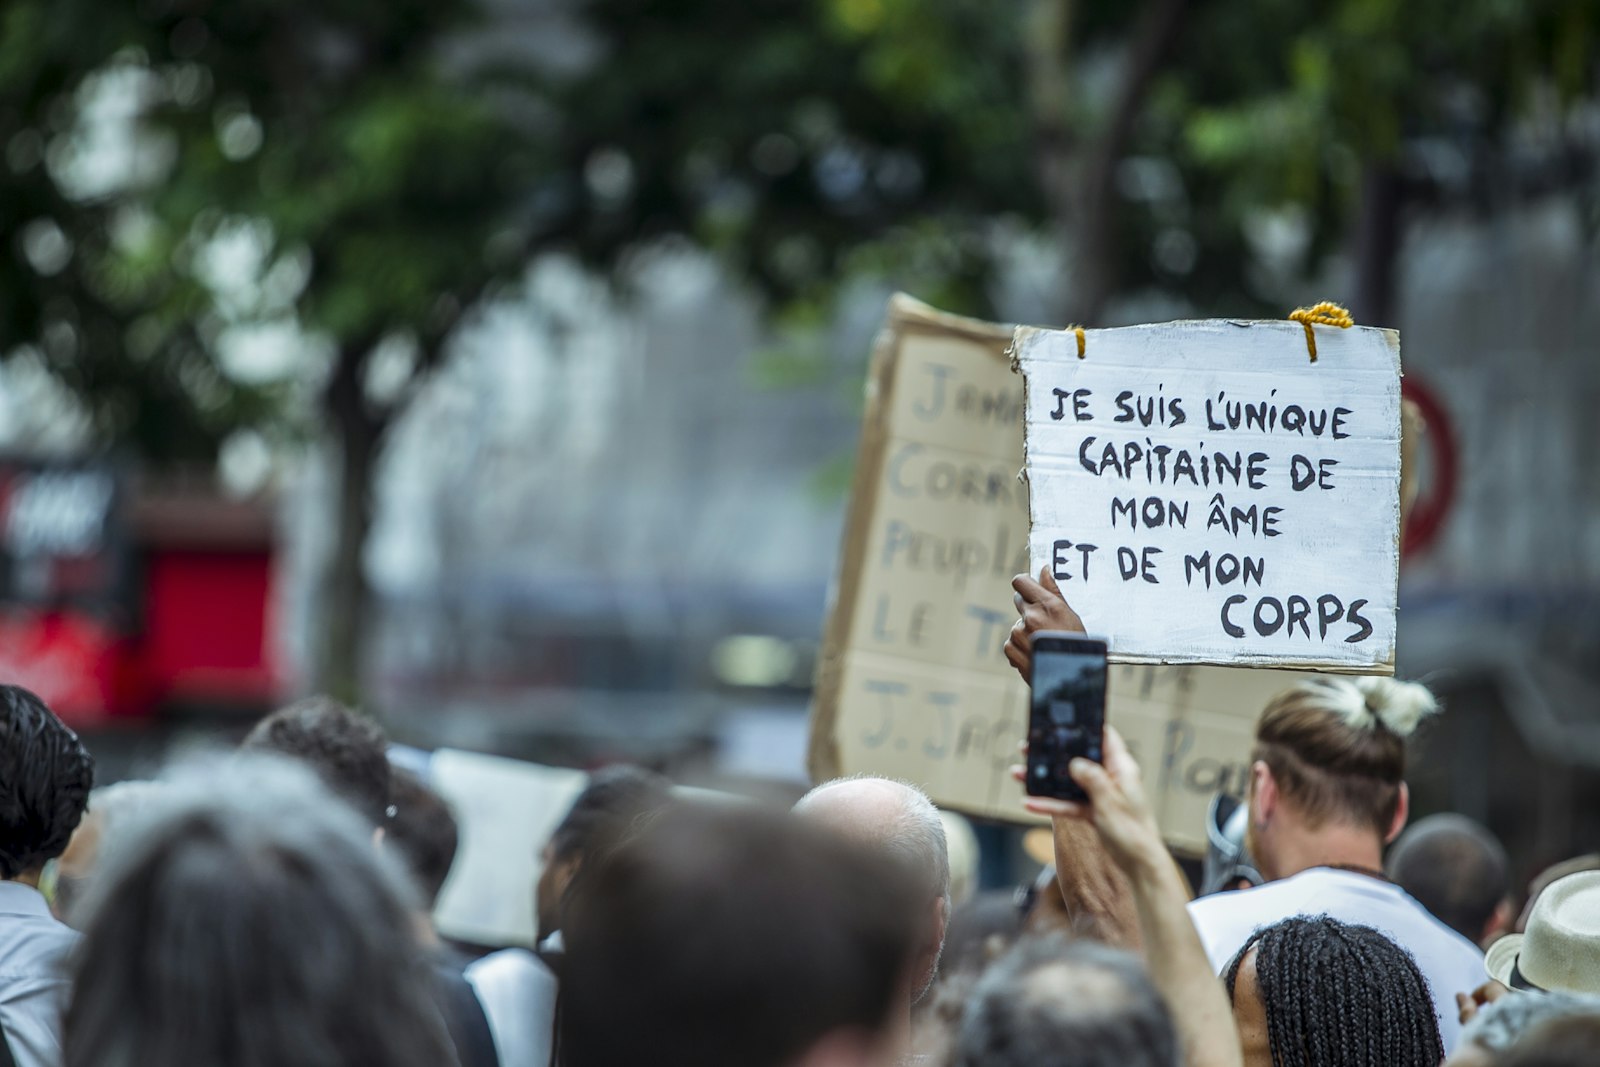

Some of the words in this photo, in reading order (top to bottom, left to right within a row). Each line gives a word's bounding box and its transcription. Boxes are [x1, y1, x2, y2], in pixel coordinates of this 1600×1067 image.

[1050, 387, 1094, 421] JE
[1290, 454, 1340, 491] DE
[1112, 497, 1188, 532] MON
[1206, 493, 1284, 538] ÂME
[1053, 540, 1098, 582] ET
[1118, 546, 1163, 583] DE
[1185, 550, 1264, 590] MON
[1221, 594, 1373, 643] CORPS
